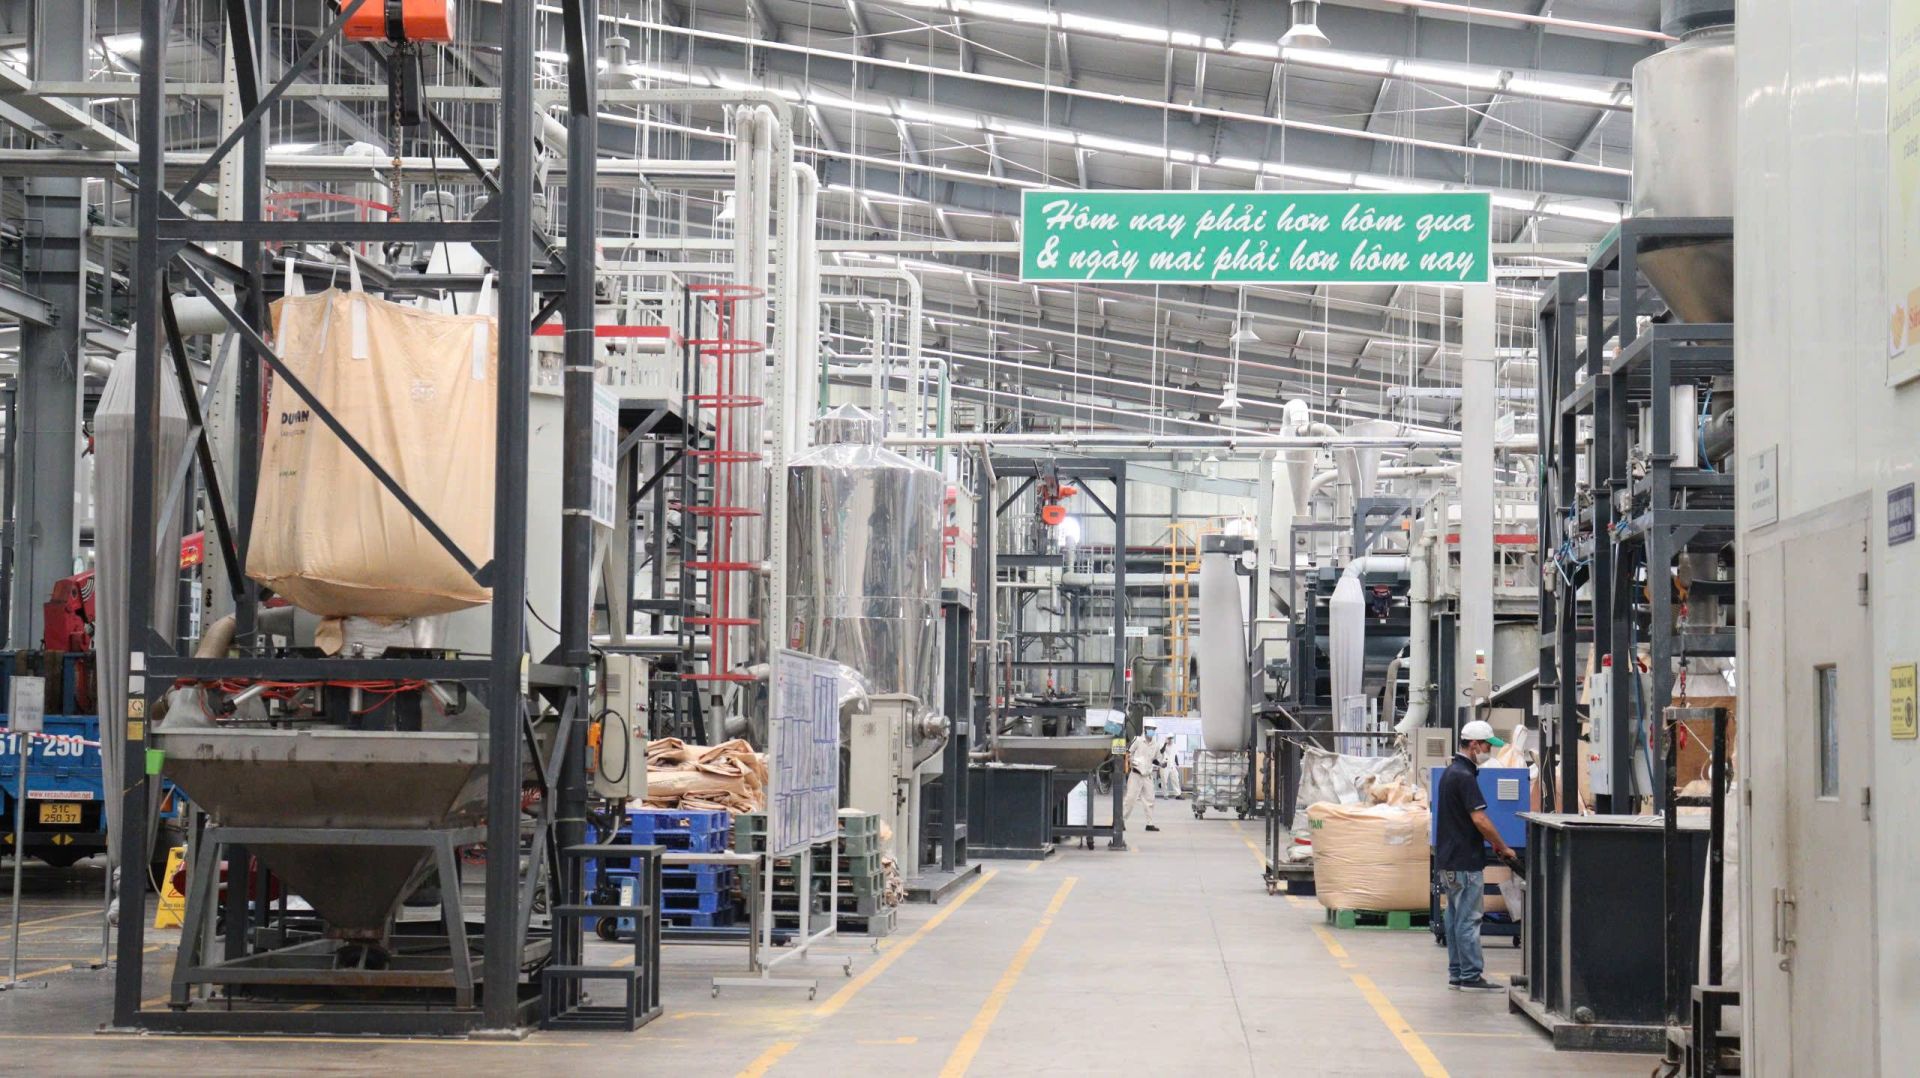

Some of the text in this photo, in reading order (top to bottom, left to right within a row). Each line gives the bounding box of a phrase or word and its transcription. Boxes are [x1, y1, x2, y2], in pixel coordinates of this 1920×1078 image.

[1041, 199, 1475, 242] Hôm nay phải hơn hôm qua
[1036, 234, 1475, 281] & ngày mai phải hơn hôm nay
[44, 814, 77, 823] 250.37
[52, 805, 70, 814] 51C
